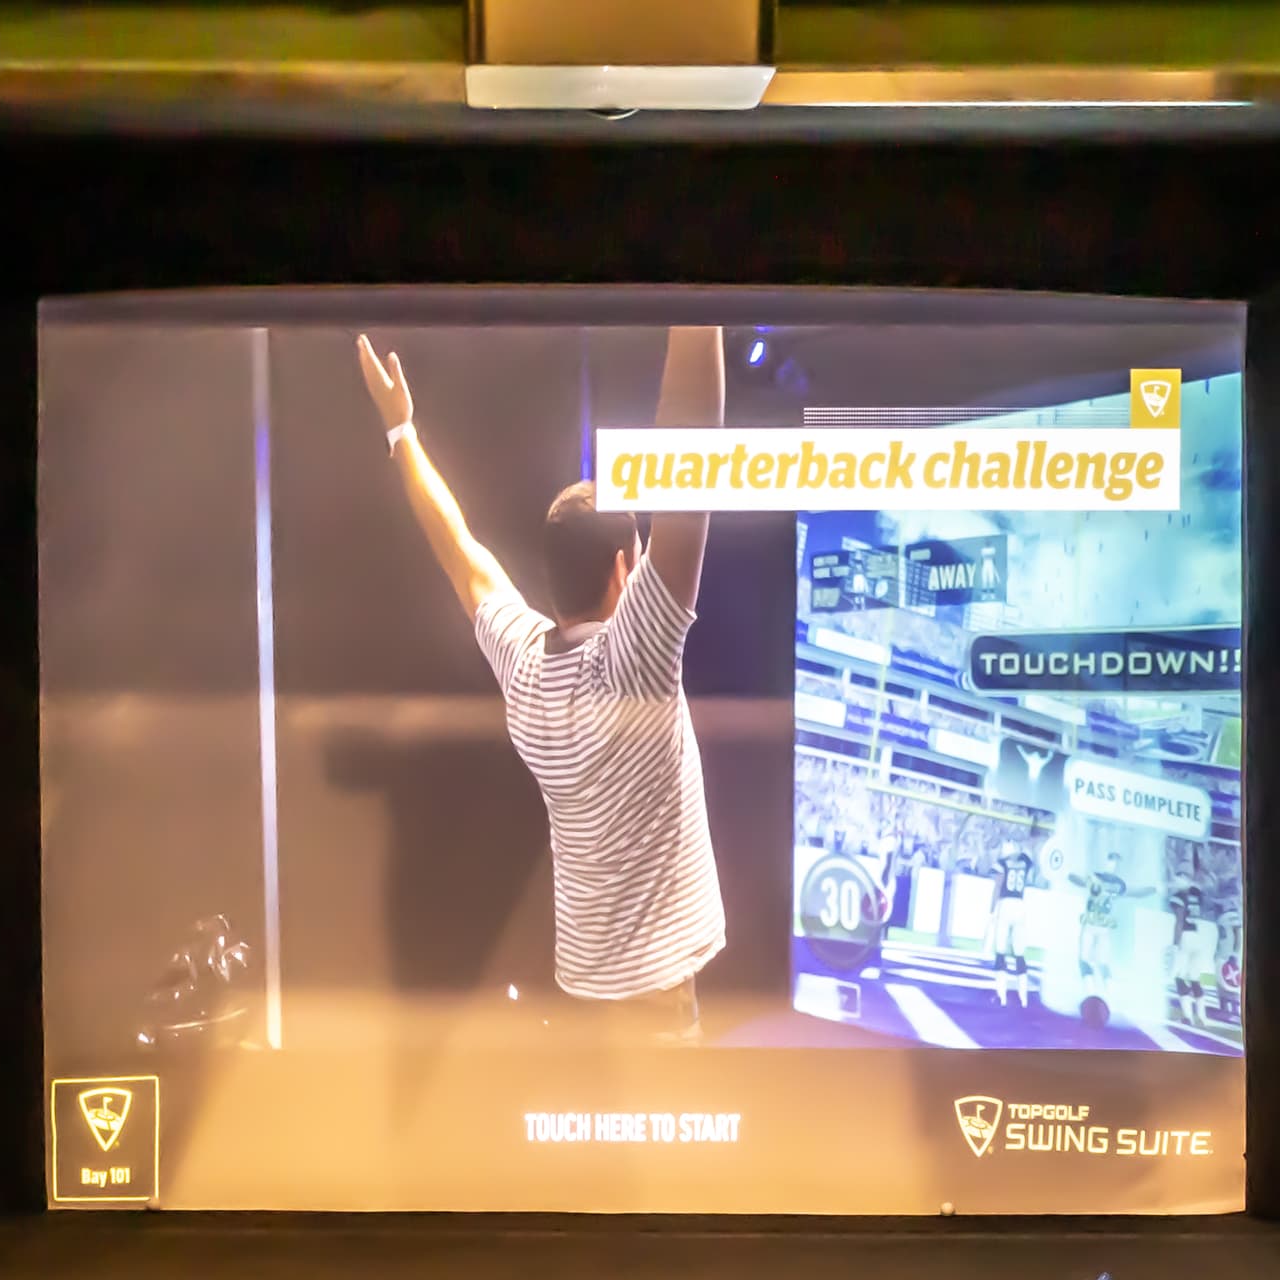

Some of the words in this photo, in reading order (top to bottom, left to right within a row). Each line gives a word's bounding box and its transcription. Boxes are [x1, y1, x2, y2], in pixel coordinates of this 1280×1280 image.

[611, 441, 918, 499] quarterback
[923, 440, 1164, 501] challenge
[928, 563, 977, 591] AWAY
[979, 648, 1241, 676] TOUCHDOWN!!
[1074, 778, 1116, 802] PASS
[1122, 788, 1202, 822] COMPLETE
[820, 876, 860, 931] 30
[524, 1112, 591, 1142] TOUCH
[594, 1112, 647, 1142] HERE
[649, 1112, 675, 1142] TO
[678, 1112, 741, 1142] START
[1007, 1103, 1090, 1121] TOPGOLF
[1004, 1123, 1109, 1154] SWING
[1115, 1129, 1212, 1156] SUITE
[81, 1167, 107, 1188] Bay
[109, 1167, 131, 1184] 101
